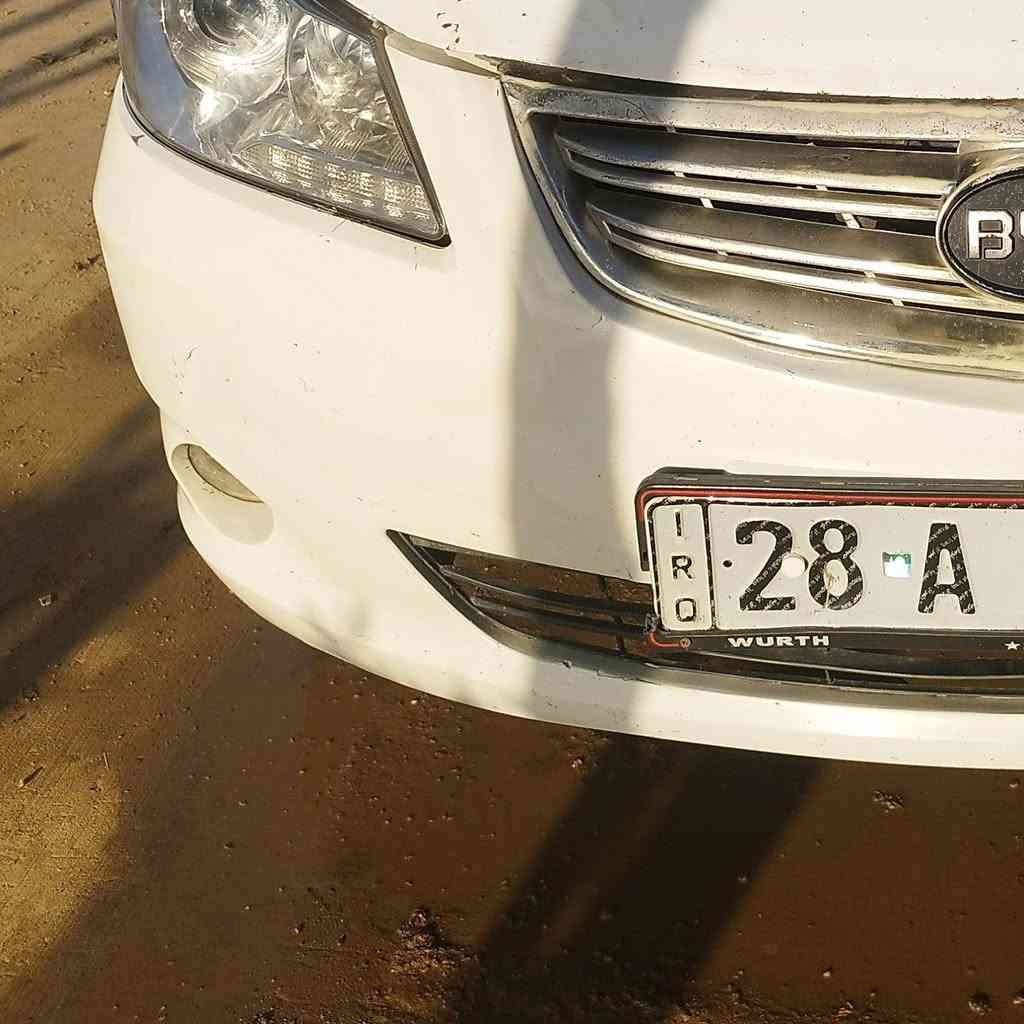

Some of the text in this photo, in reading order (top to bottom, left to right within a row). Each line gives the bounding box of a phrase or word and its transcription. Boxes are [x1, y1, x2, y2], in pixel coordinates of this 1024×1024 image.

[735, 519, 864, 611] 28
[917, 523, 976, 615] A
[727, 636, 830, 647] WURTH
